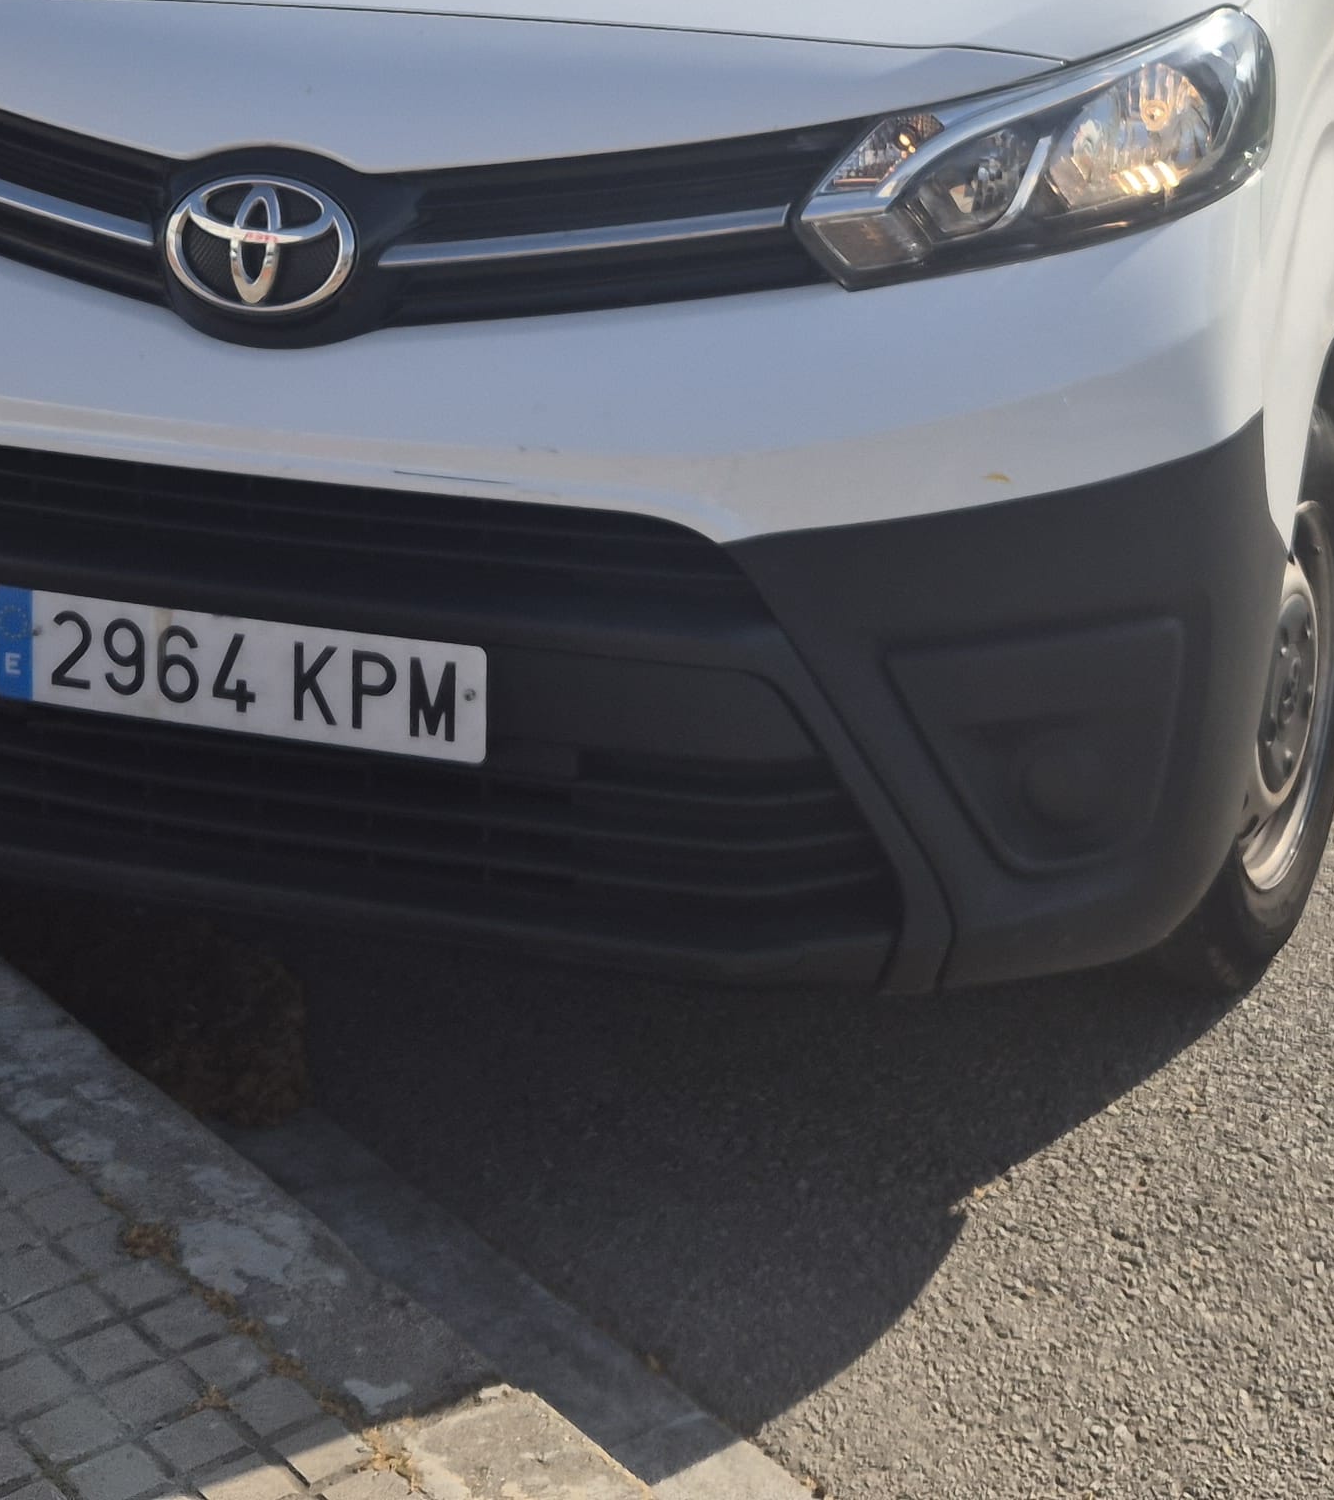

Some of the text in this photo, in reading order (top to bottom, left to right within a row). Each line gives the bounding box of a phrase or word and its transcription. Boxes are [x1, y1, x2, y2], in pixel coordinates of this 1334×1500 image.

[5, 653, 22, 675] E
[51, 610, 456, 742] 2964 KPM
